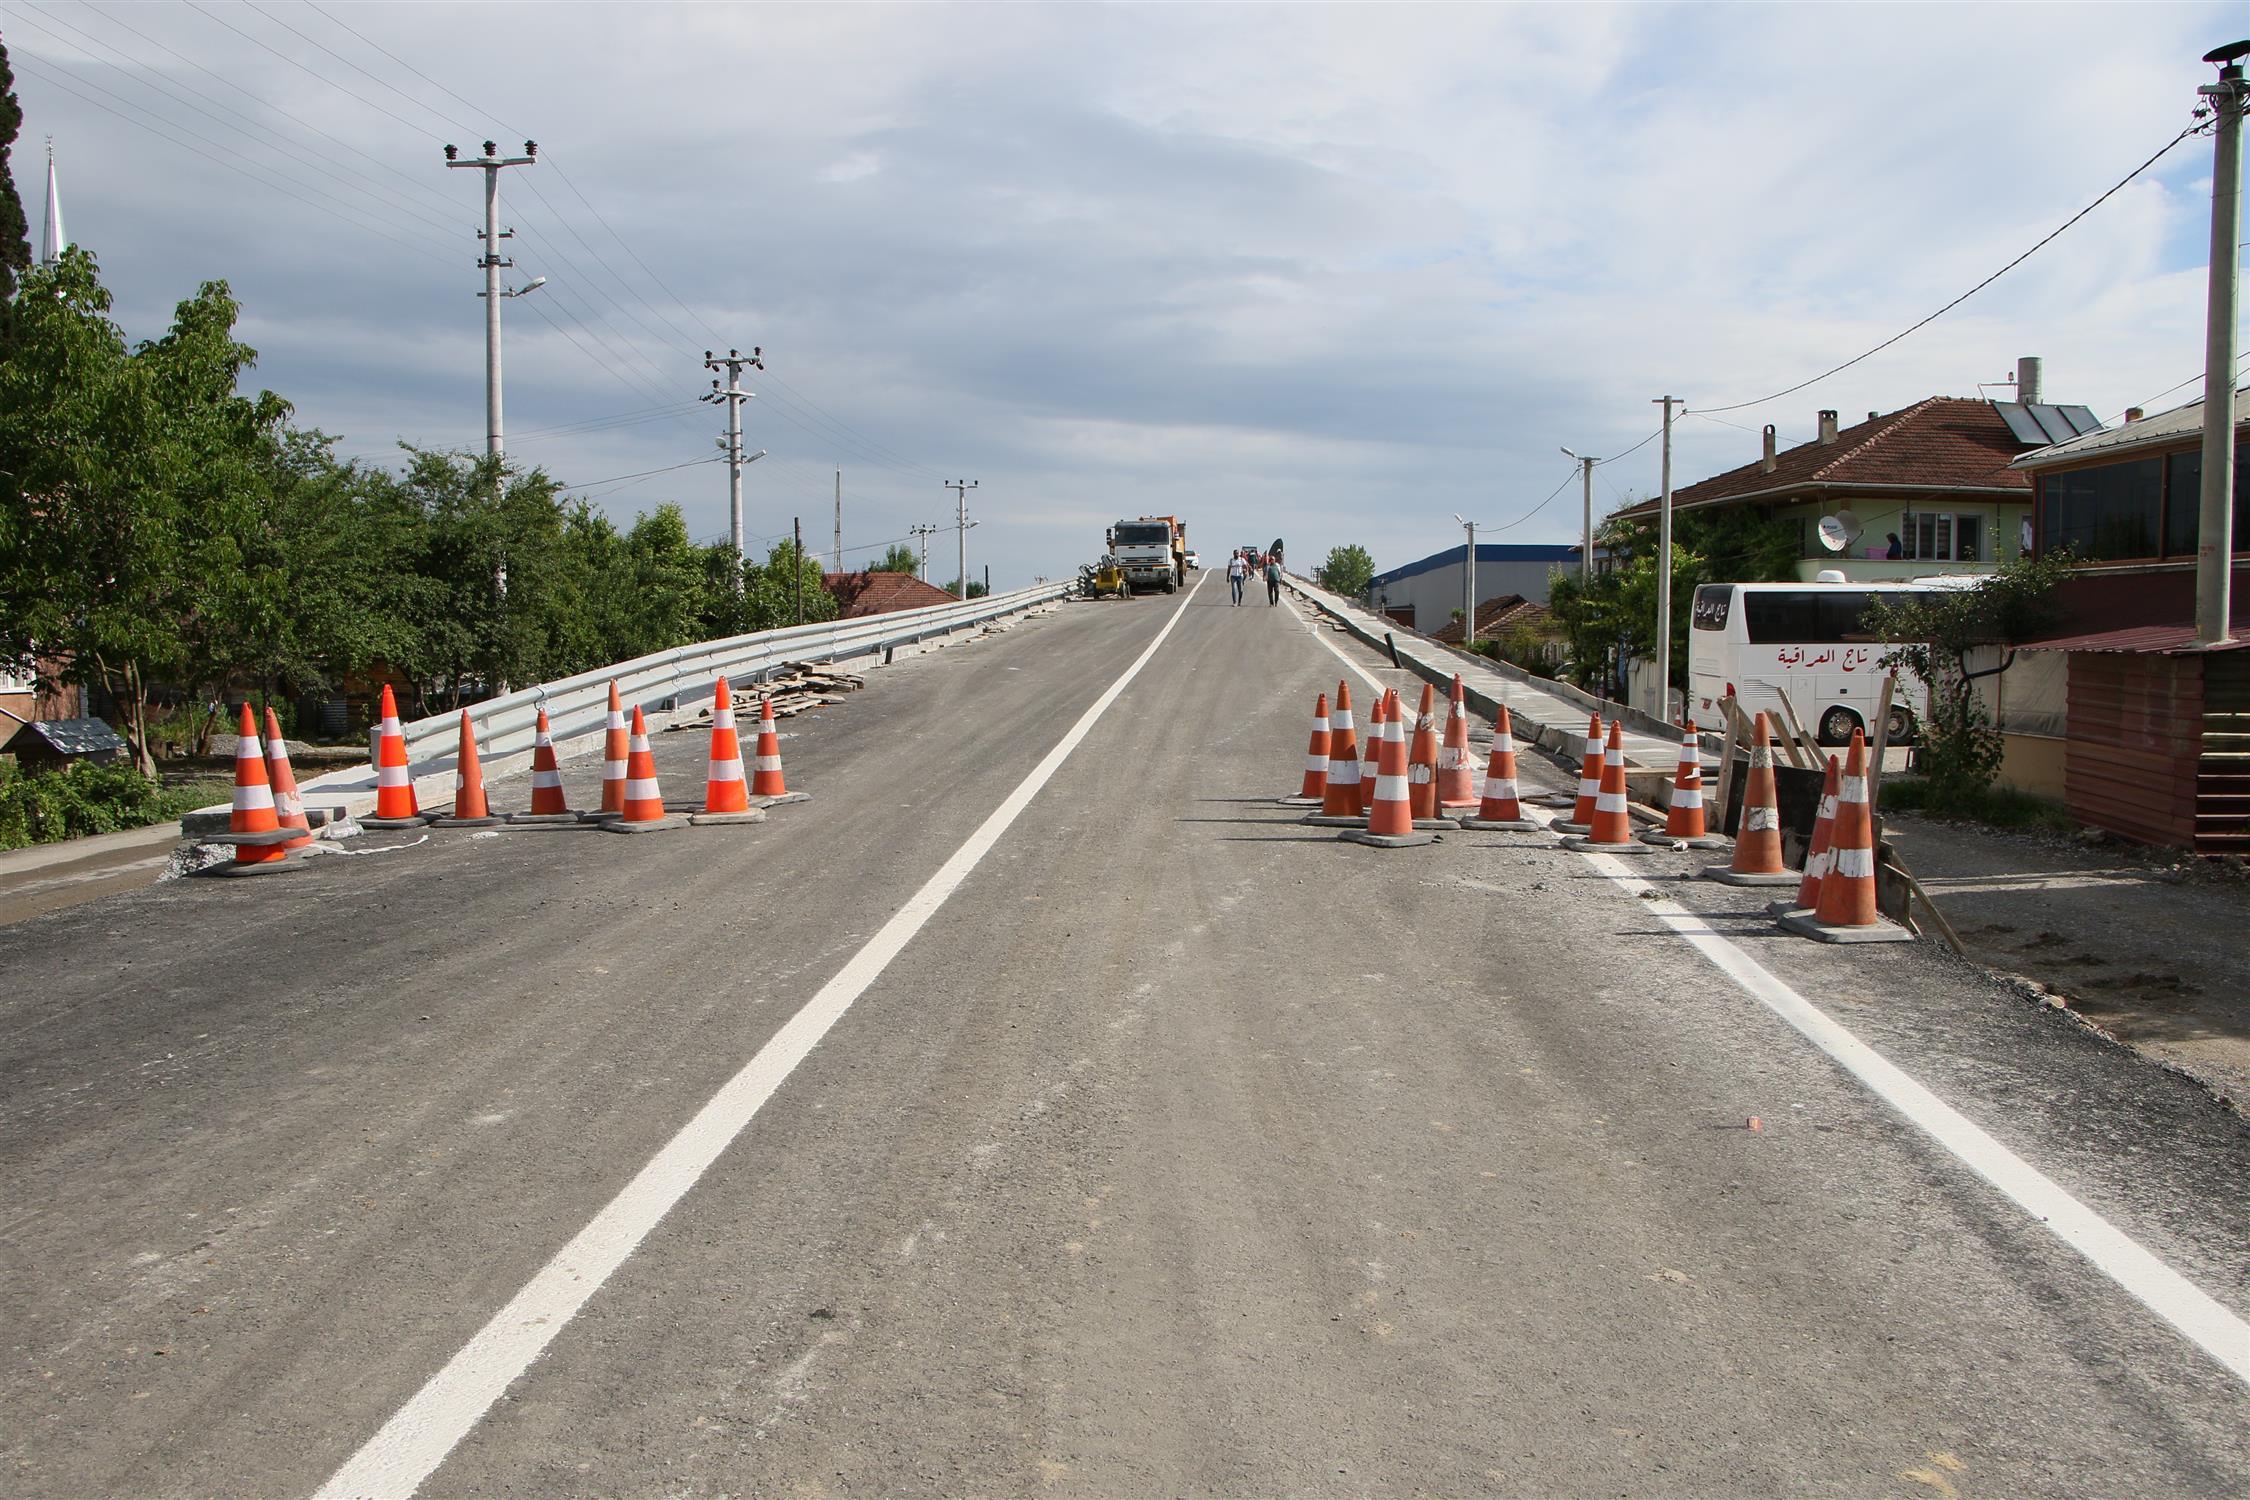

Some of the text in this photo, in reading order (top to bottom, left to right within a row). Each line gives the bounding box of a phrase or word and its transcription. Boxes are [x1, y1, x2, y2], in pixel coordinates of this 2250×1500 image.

[1714, 603, 1727, 623] تاج
[1777, 647, 1868, 672] تاج العراقية
